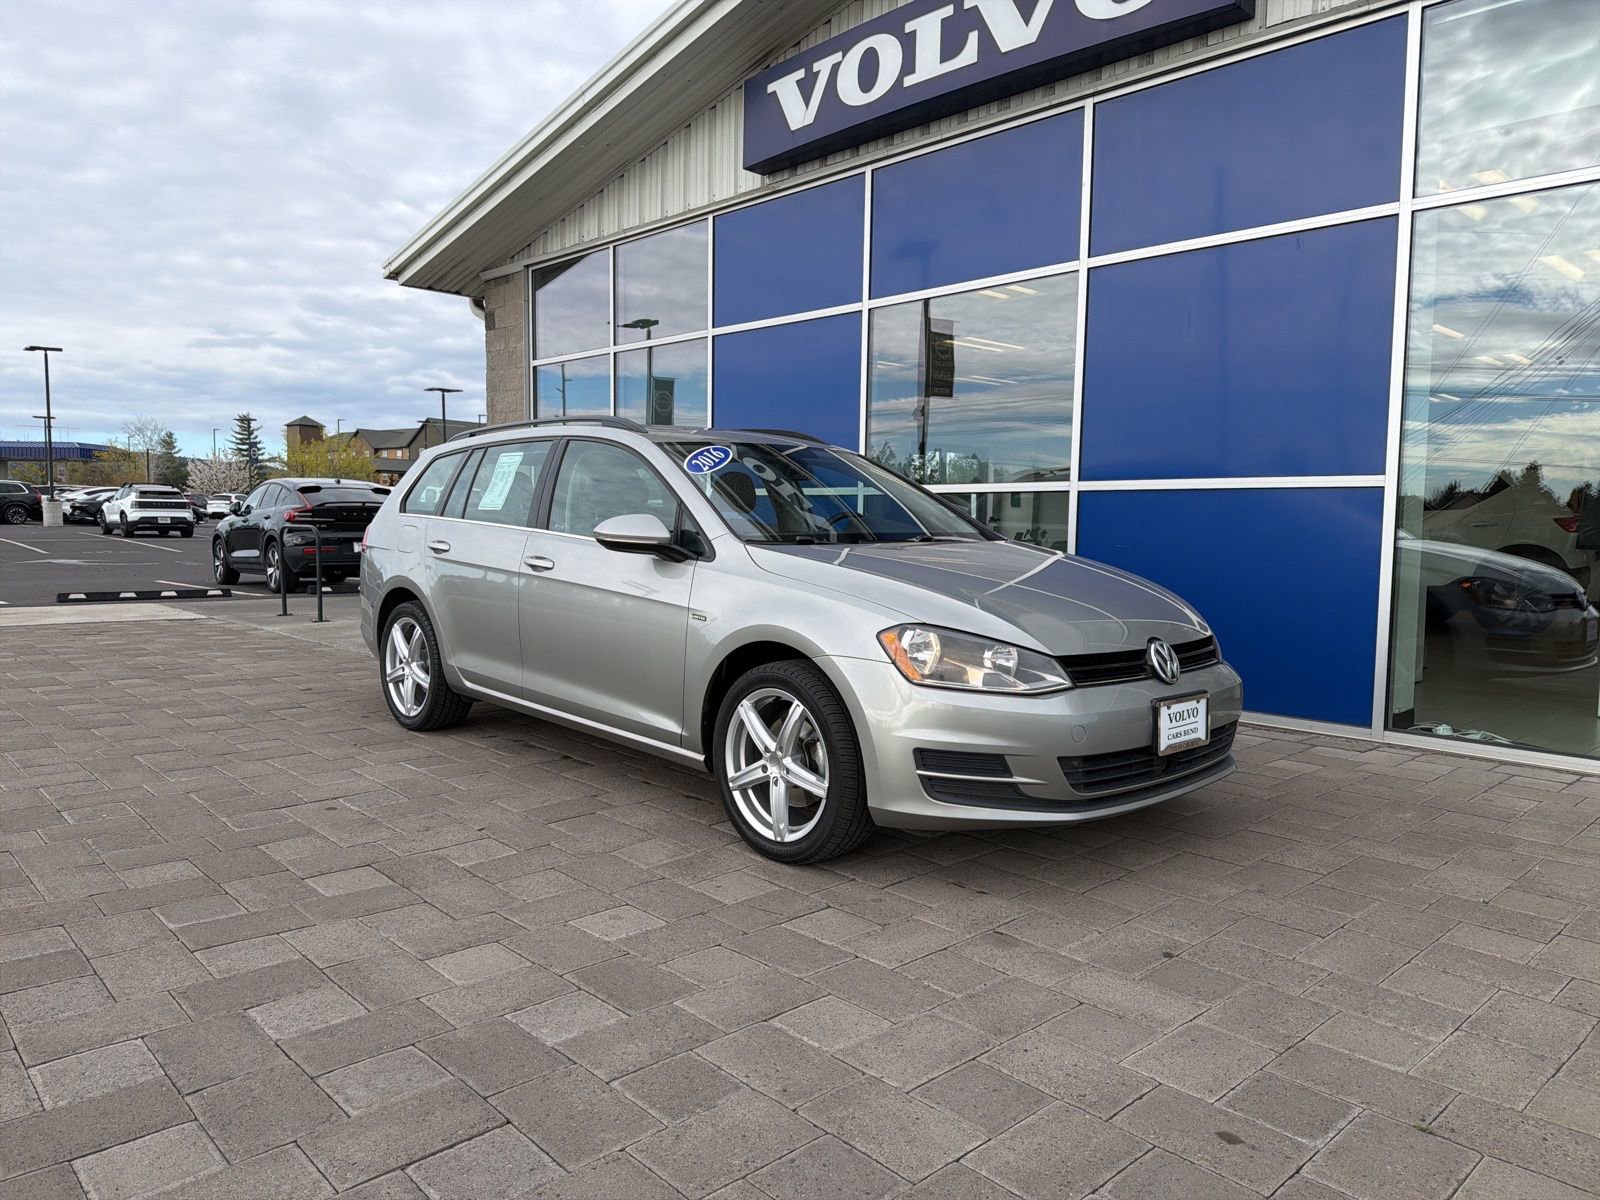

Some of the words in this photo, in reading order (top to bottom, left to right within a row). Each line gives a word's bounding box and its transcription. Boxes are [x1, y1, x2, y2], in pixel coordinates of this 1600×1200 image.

[766, 0, 1151, 131] VOLV
[691, 447, 725, 472] 2016
[1168, 707, 1199, 724] VOLVO
[1167, 731, 1182, 741] CARS
[1183, 727, 1199, 737] BEND
